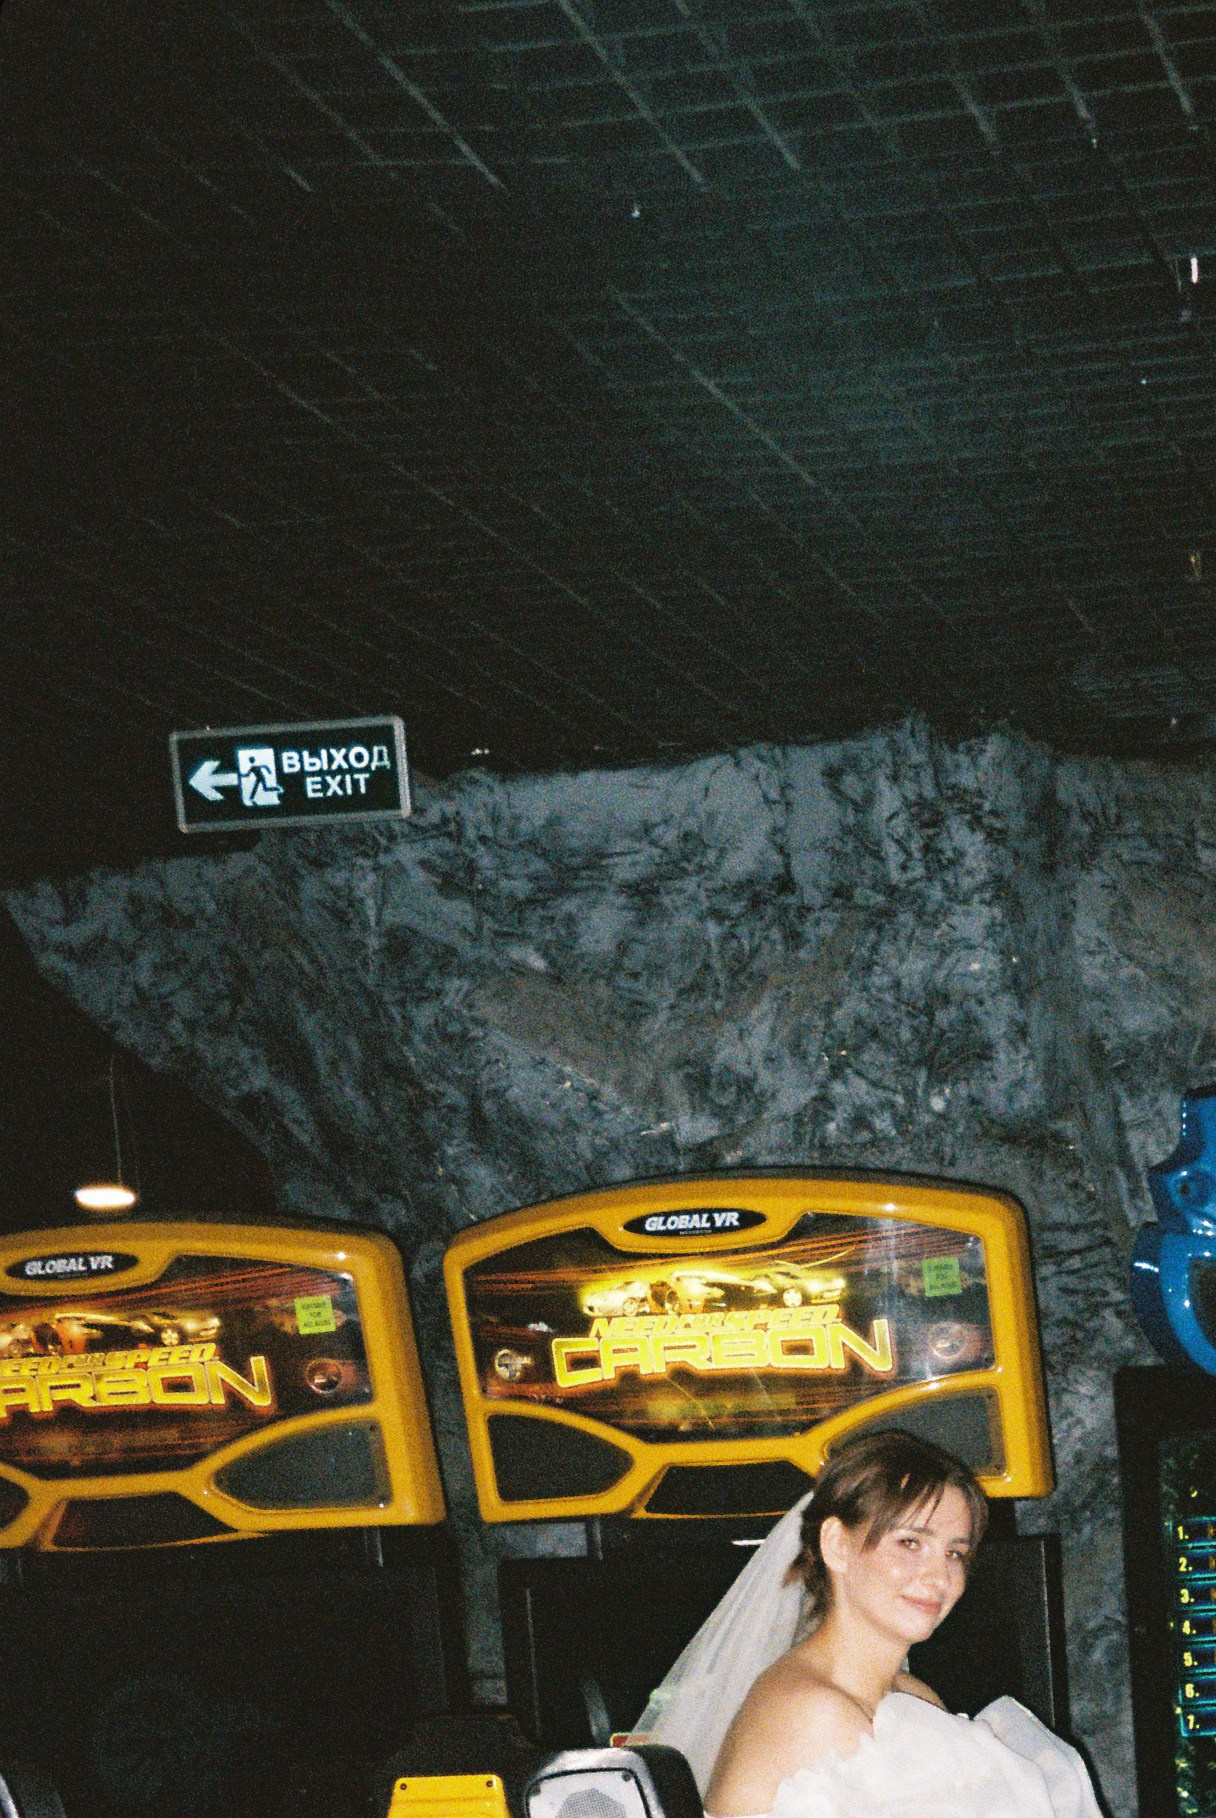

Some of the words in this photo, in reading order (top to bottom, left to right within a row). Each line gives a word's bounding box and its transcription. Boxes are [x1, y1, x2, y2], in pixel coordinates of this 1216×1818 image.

[282, 745, 392, 774] ВЫХОД
[306, 773, 370, 798] EXIT
[645, 1213, 711, 1233] GLOBAL
[712, 1211, 741, 1228] VR
[25, 1255, 86, 1276] GLOBAL
[88, 1254, 114, 1270] VR
[588, 1315, 680, 1338] NEED
[724, 1304, 838, 1330] SPEED
[0, 1357, 61, 1377] EED
[105, 1343, 217, 1368] SPEED
[551, 1318, 894, 1389] CARBON
[0, 1355, 272, 1417] ARBON
[1179, 1557, 1193, 1572] 2.
[1180, 1588, 1195, 1604] 3.
